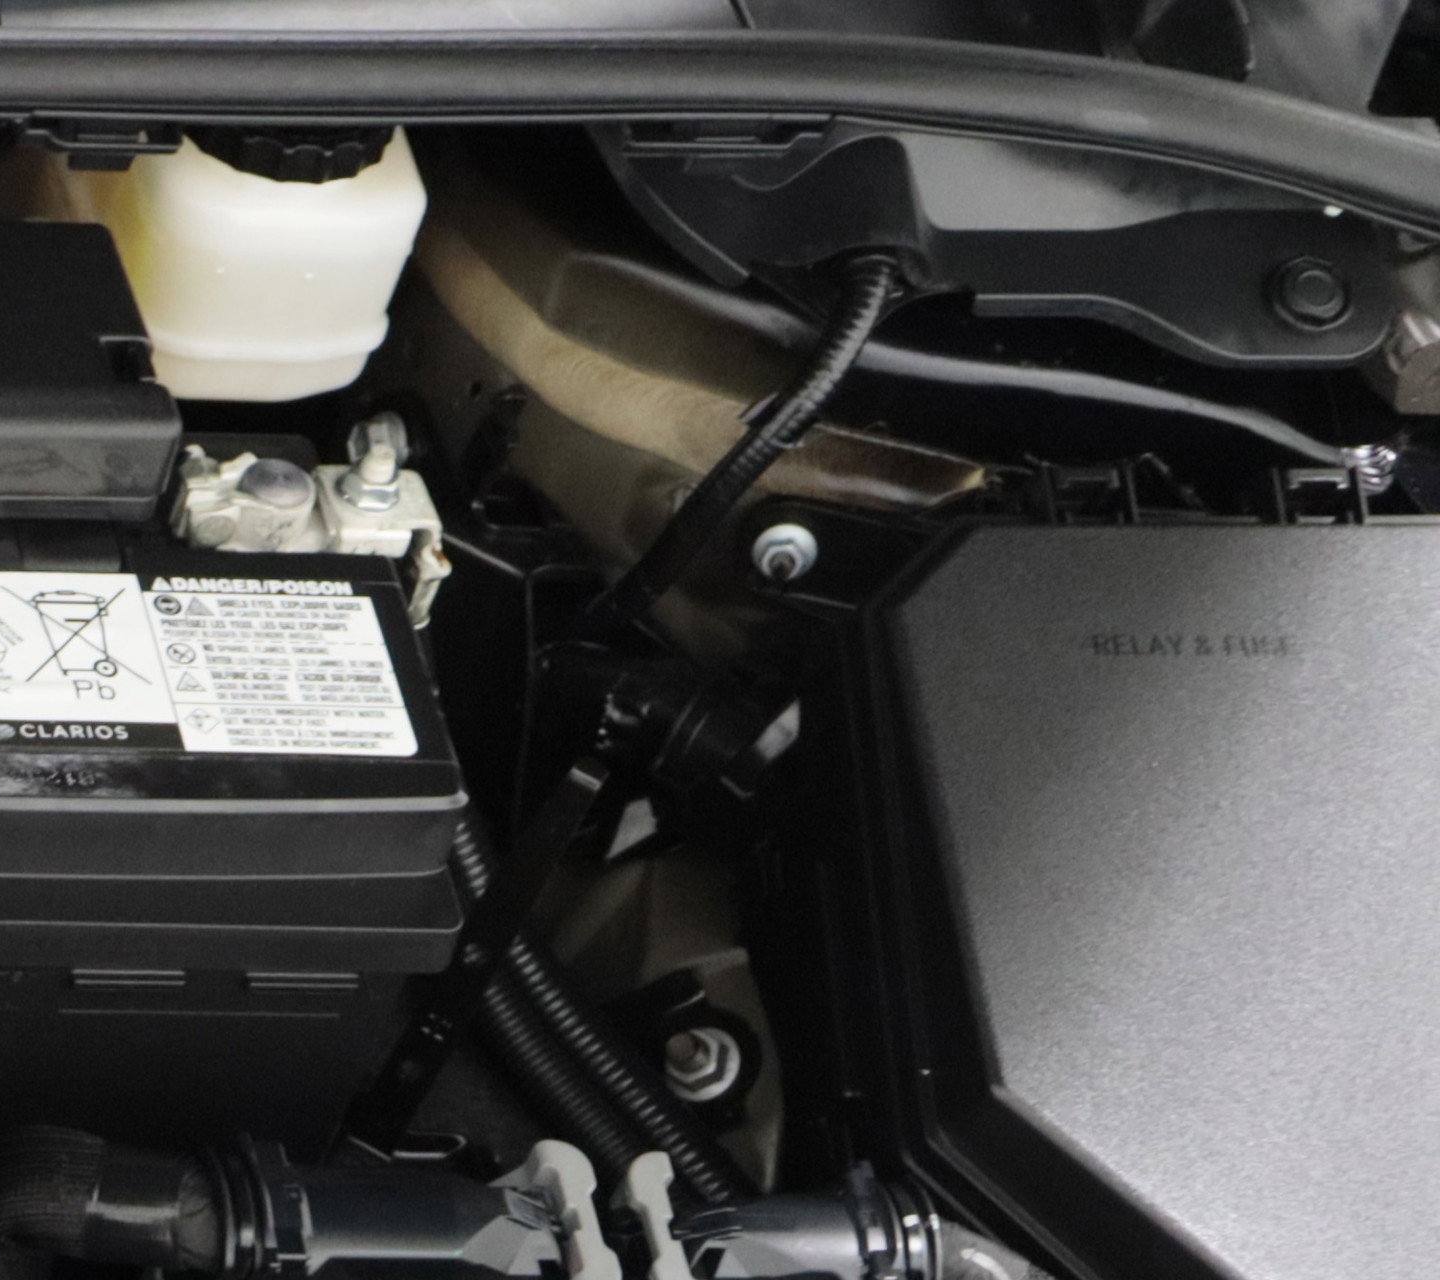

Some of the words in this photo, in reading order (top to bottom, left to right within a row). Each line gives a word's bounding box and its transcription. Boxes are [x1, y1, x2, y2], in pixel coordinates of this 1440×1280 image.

[170, 577, 353, 597] DANGER/POISON
[1091, 633, 1182, 656] RELAY
[73, 679, 116, 701] Pb
[20, 723, 129, 740] CLARIOS
